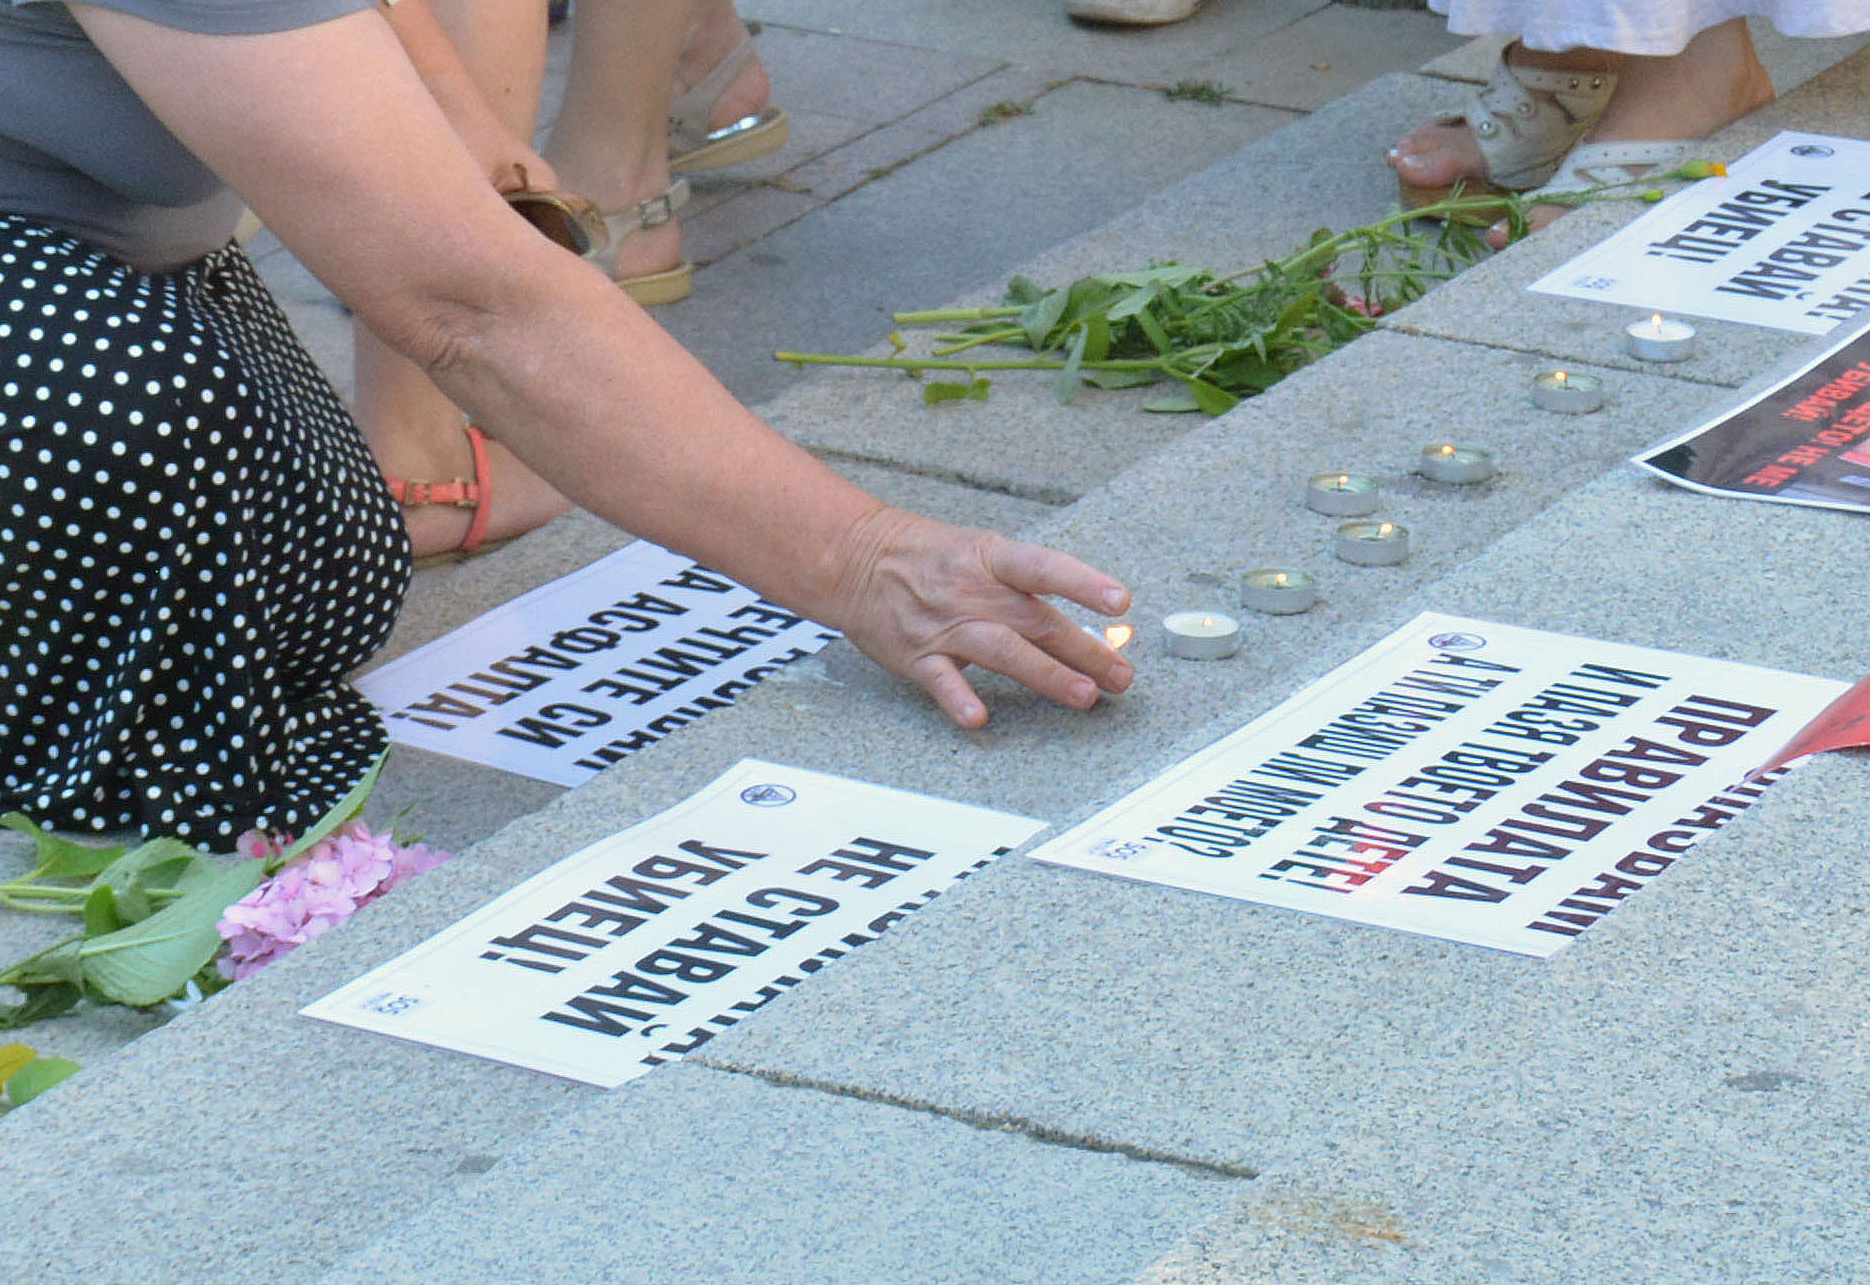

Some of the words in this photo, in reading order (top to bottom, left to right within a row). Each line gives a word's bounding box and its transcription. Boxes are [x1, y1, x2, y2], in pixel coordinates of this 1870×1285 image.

[1644, 179, 1831, 264] УБИЕЦ!
[1743, 464, 1799, 488] МЕ
[1778, 445, 1830, 466] НЕ
[658, 565, 735, 594] А
[388, 591, 690, 731] АСФАЛТА!
[580, 600, 803, 705] ЕЧТИТЕ
[1391, 669, 1505, 699] ТИ
[1427, 653, 1523, 674] А
[1568, 663, 1672, 689] И
[496, 702, 612, 749] СИ
[1293, 691, 1467, 761] ПАЗИШ
[1481, 683, 1643, 747] ПАЗЯ
[1248, 751, 1367, 788] ЛИ
[1362, 742, 1557, 825] ТВОЕТО
[1399, 695, 1777, 904] ПРАВИЛАТА
[1140, 780, 1325, 859] МОЕТО?
[795, 836, 936, 891] НЕ
[1255, 816, 1431, 894] ДЕТЕ!
[479, 838, 769, 976] УБИЕЦ!
[539, 889, 840, 1039] СТАВАЙ
